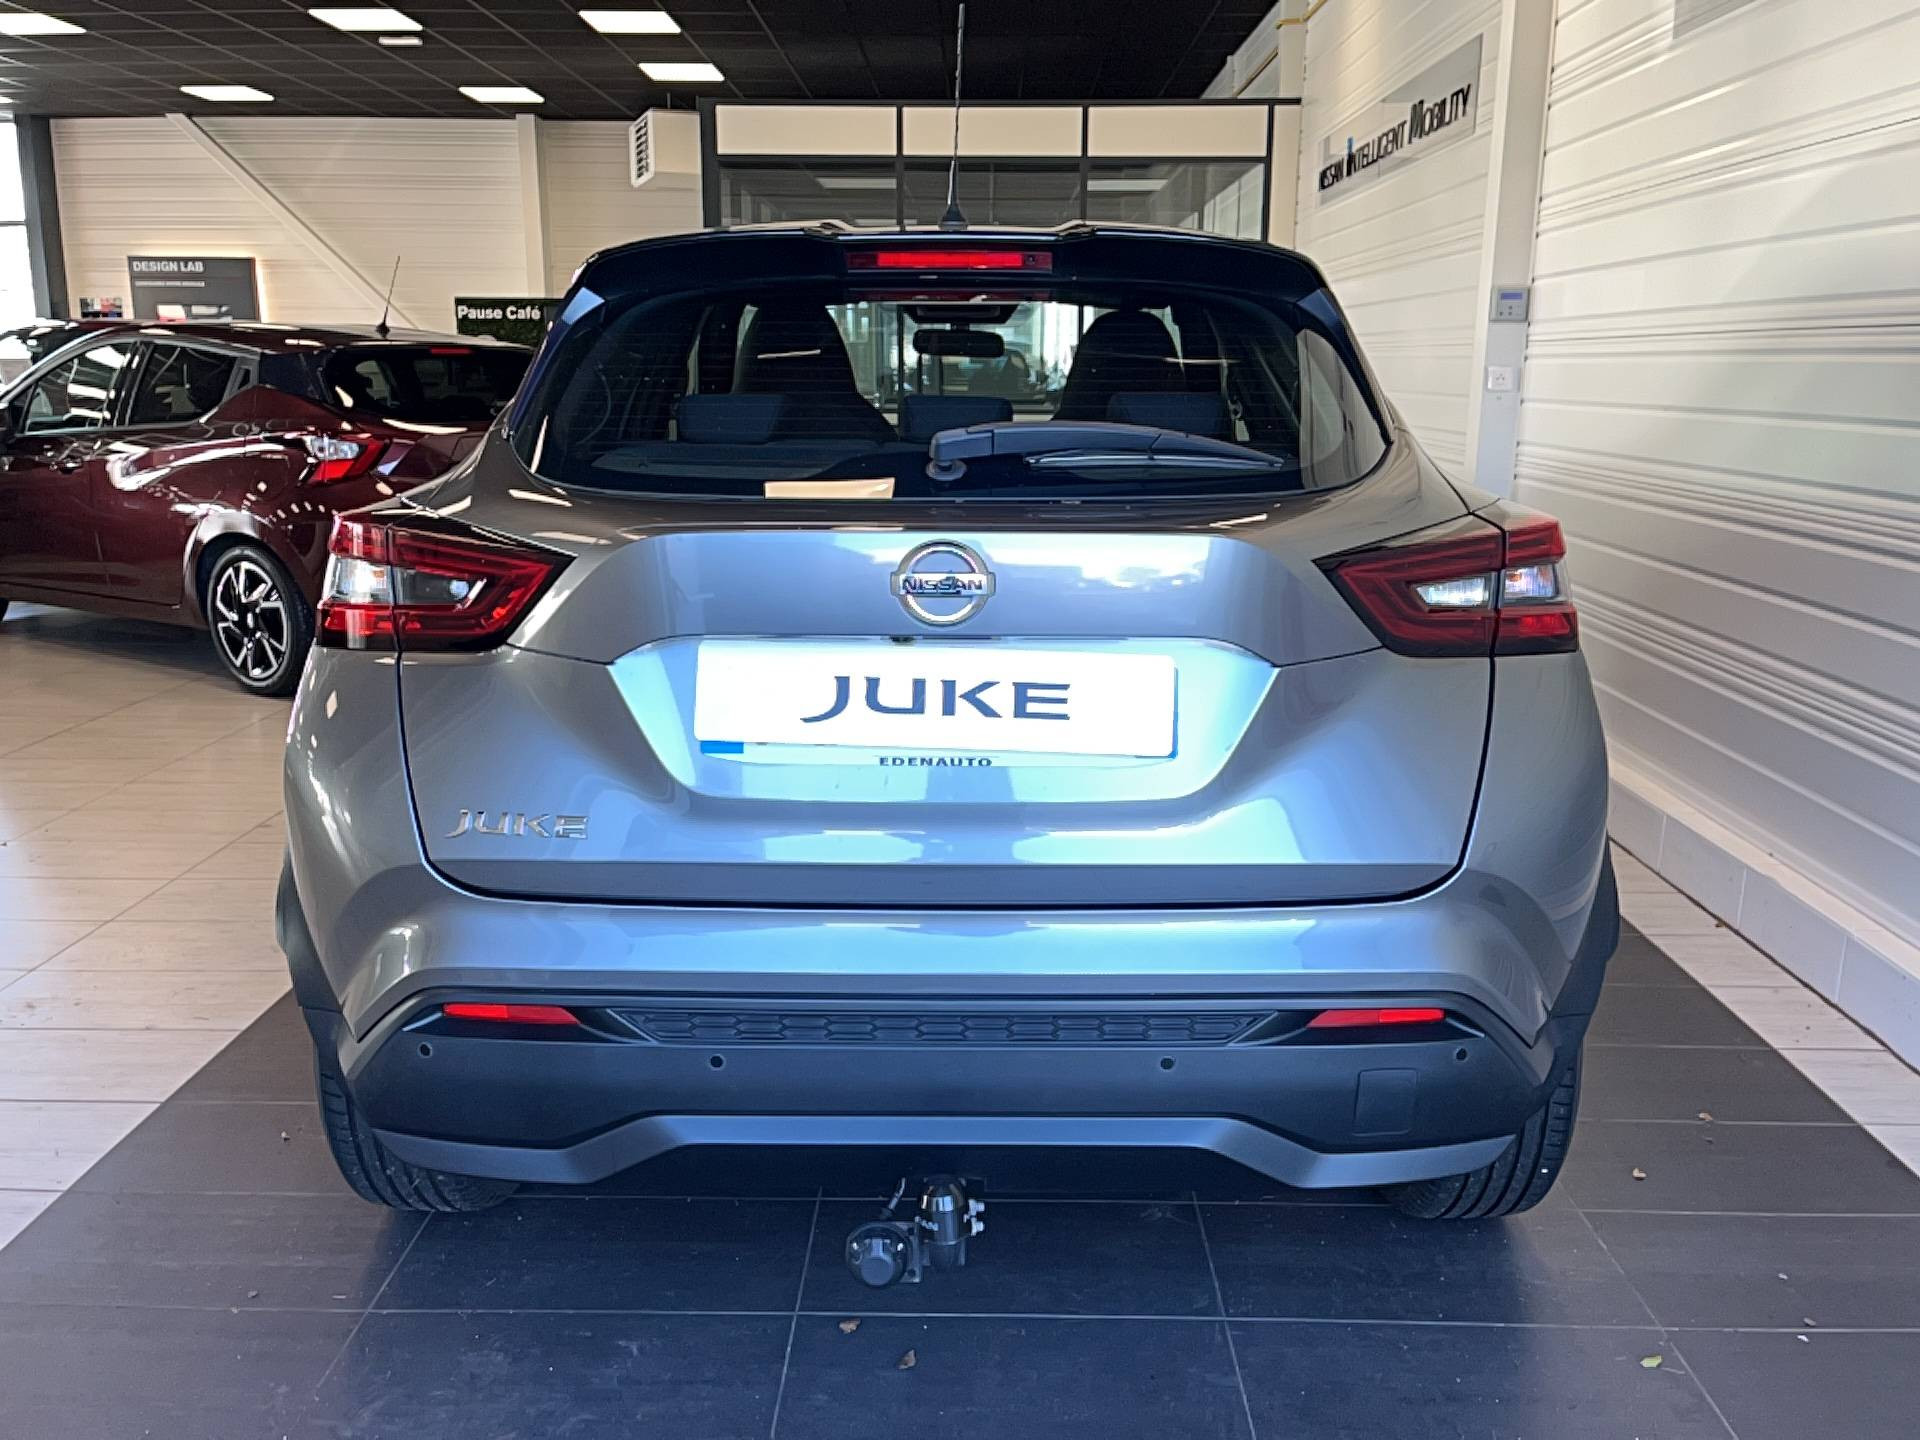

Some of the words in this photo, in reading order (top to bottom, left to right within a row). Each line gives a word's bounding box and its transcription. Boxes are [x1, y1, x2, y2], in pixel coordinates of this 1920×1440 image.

[1408, 83, 1471, 144] MOBILITY
[132, 261, 178, 272] DESIGN
[180, 261, 204, 272] LAB
[457, 305, 503, 320] Pause
[506, 305, 541, 320] Café
[902, 577, 983, 592] NISSAN
[800, 675, 1070, 723] JUKE
[879, 757, 993, 767] EDENAUTO
[444, 809, 589, 839] JUKE
